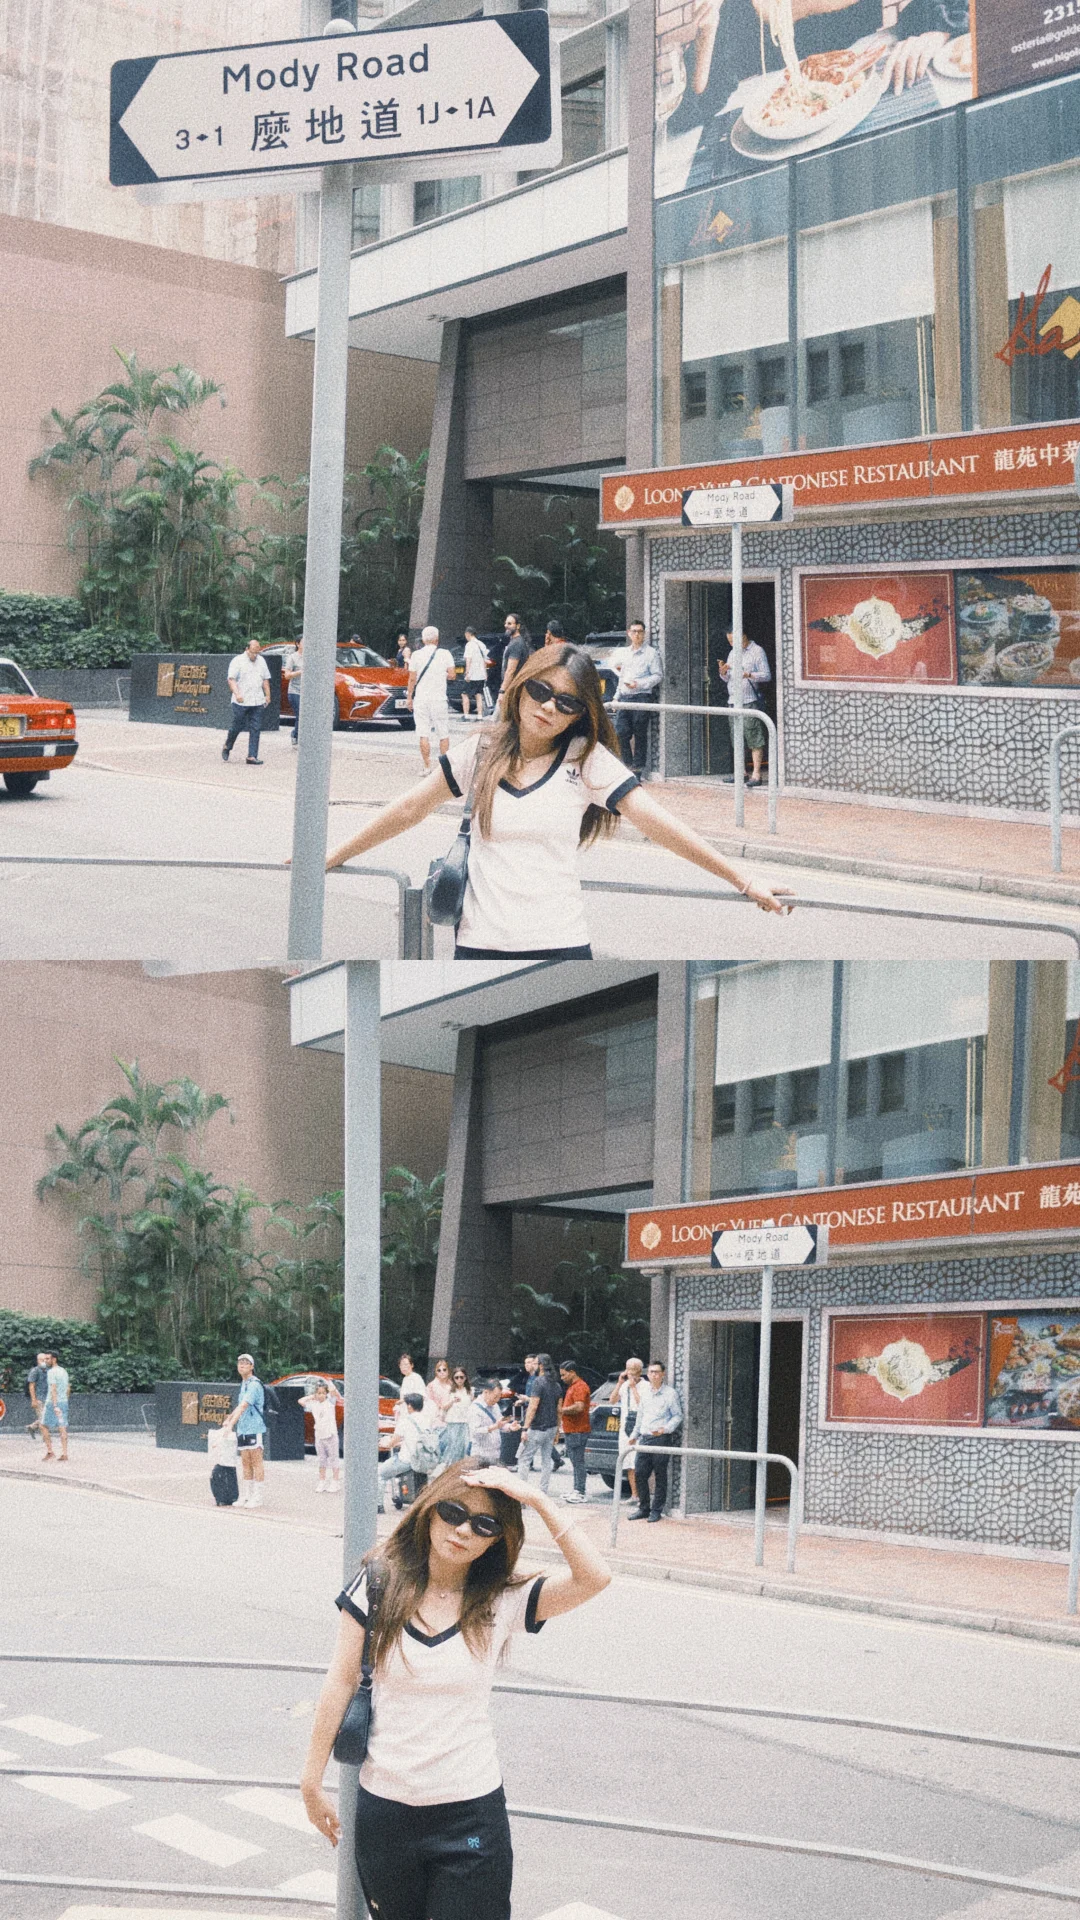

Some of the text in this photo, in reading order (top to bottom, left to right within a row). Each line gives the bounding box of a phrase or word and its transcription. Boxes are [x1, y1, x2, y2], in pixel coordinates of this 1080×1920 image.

[223, 43, 429, 95] Mody Road
[853, 455, 980, 485] RESTAURANT
[733, 490, 756, 501] Road
[892, 1190, 1025, 1223] RESTAURANT
[738, 1232, 789, 1245] Mody Road
